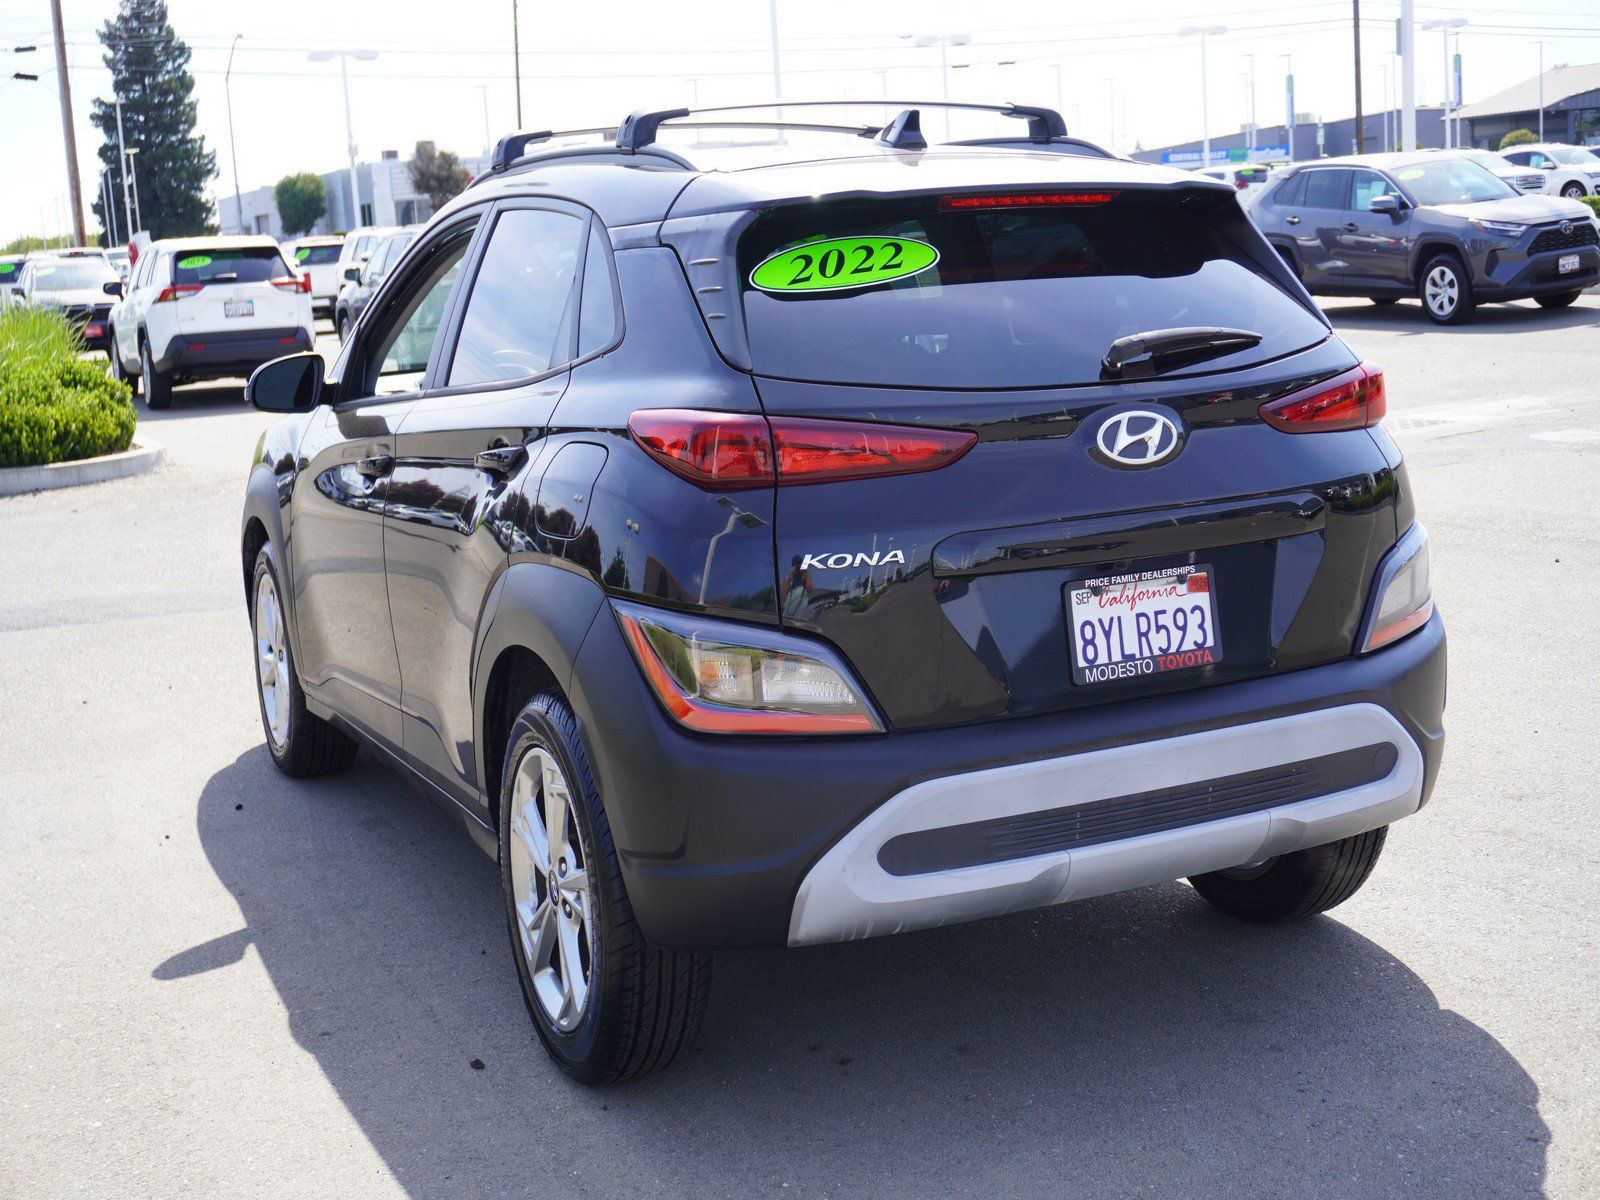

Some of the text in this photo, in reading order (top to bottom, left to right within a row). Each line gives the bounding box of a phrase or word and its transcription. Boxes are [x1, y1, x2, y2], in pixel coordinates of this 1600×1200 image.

[787, 242, 904, 286] 2022
[800, 549, 906, 571] KONA
[1085, 565, 1196, 588] PRICE FAMILY DEALERSHIPS
[1075, 590, 1092, 605] SEP
[1098, 583, 1188, 611] California
[1079, 604, 1208, 666] 8YLR593
[1085, 649, 1214, 683] MODESTO TOYOTA
